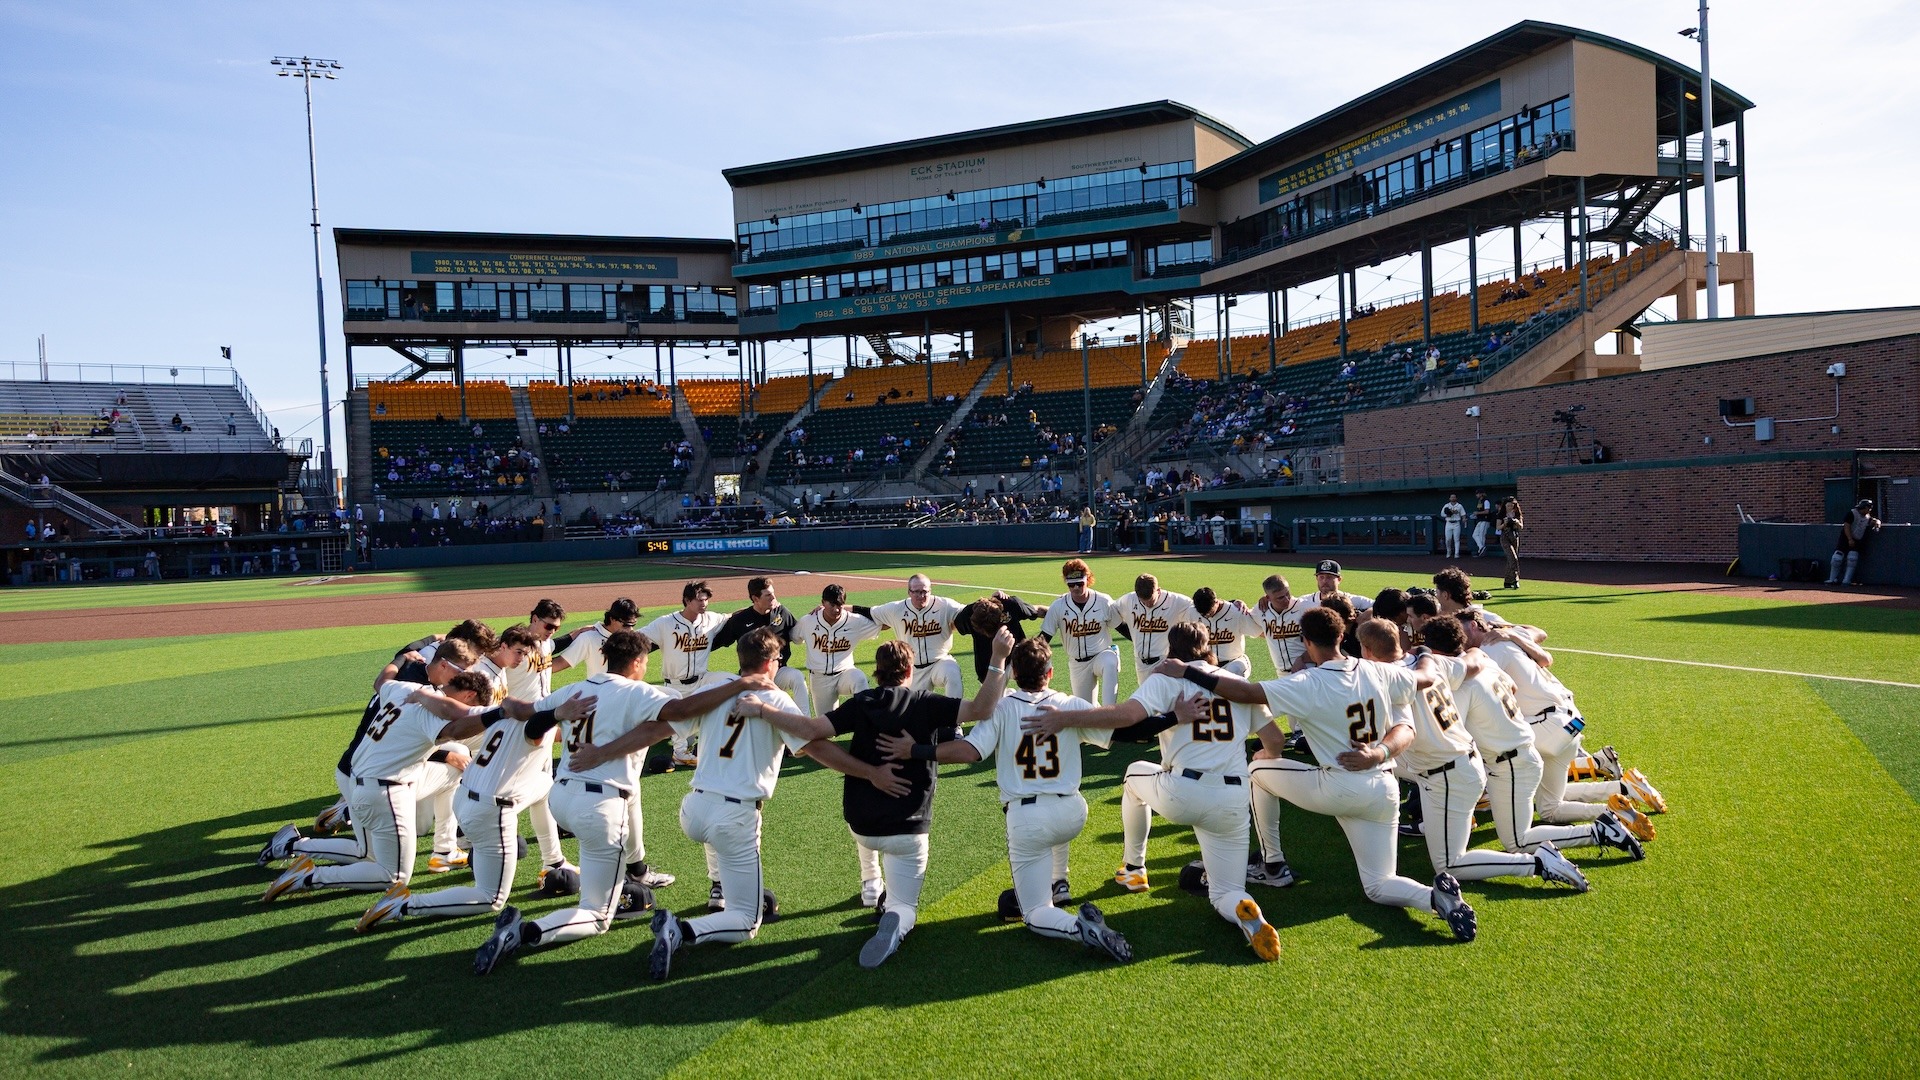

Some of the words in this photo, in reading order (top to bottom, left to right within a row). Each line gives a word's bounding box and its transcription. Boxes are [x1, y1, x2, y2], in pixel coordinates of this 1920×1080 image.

[910, 165, 932, 175] ECK
[936, 158, 985, 172] STADIUM
[854, 250, 874, 260] 1989
[884, 243, 933, 256] NATIONAL
[936, 235, 996, 250] CHAMPIONS
[854, 295, 897, 306] COLLEGE
[900, 290, 935, 300] WORLD
[937, 286, 971, 296] SERIES
[975, 278, 1051, 293] APPEARANCES
[647, 541, 668, 551] 5:46
[688, 540, 722, 550] KOCH
[736, 539, 768, 548] KOCH
[901, 619, 942, 636] Wichita
[719, 713, 745, 758] 7
[1192, 698, 1234, 742] 29
[1346, 698, 1378, 743] 21
[476, 730, 504, 767] 9
[1015, 733, 1060, 780] 43
